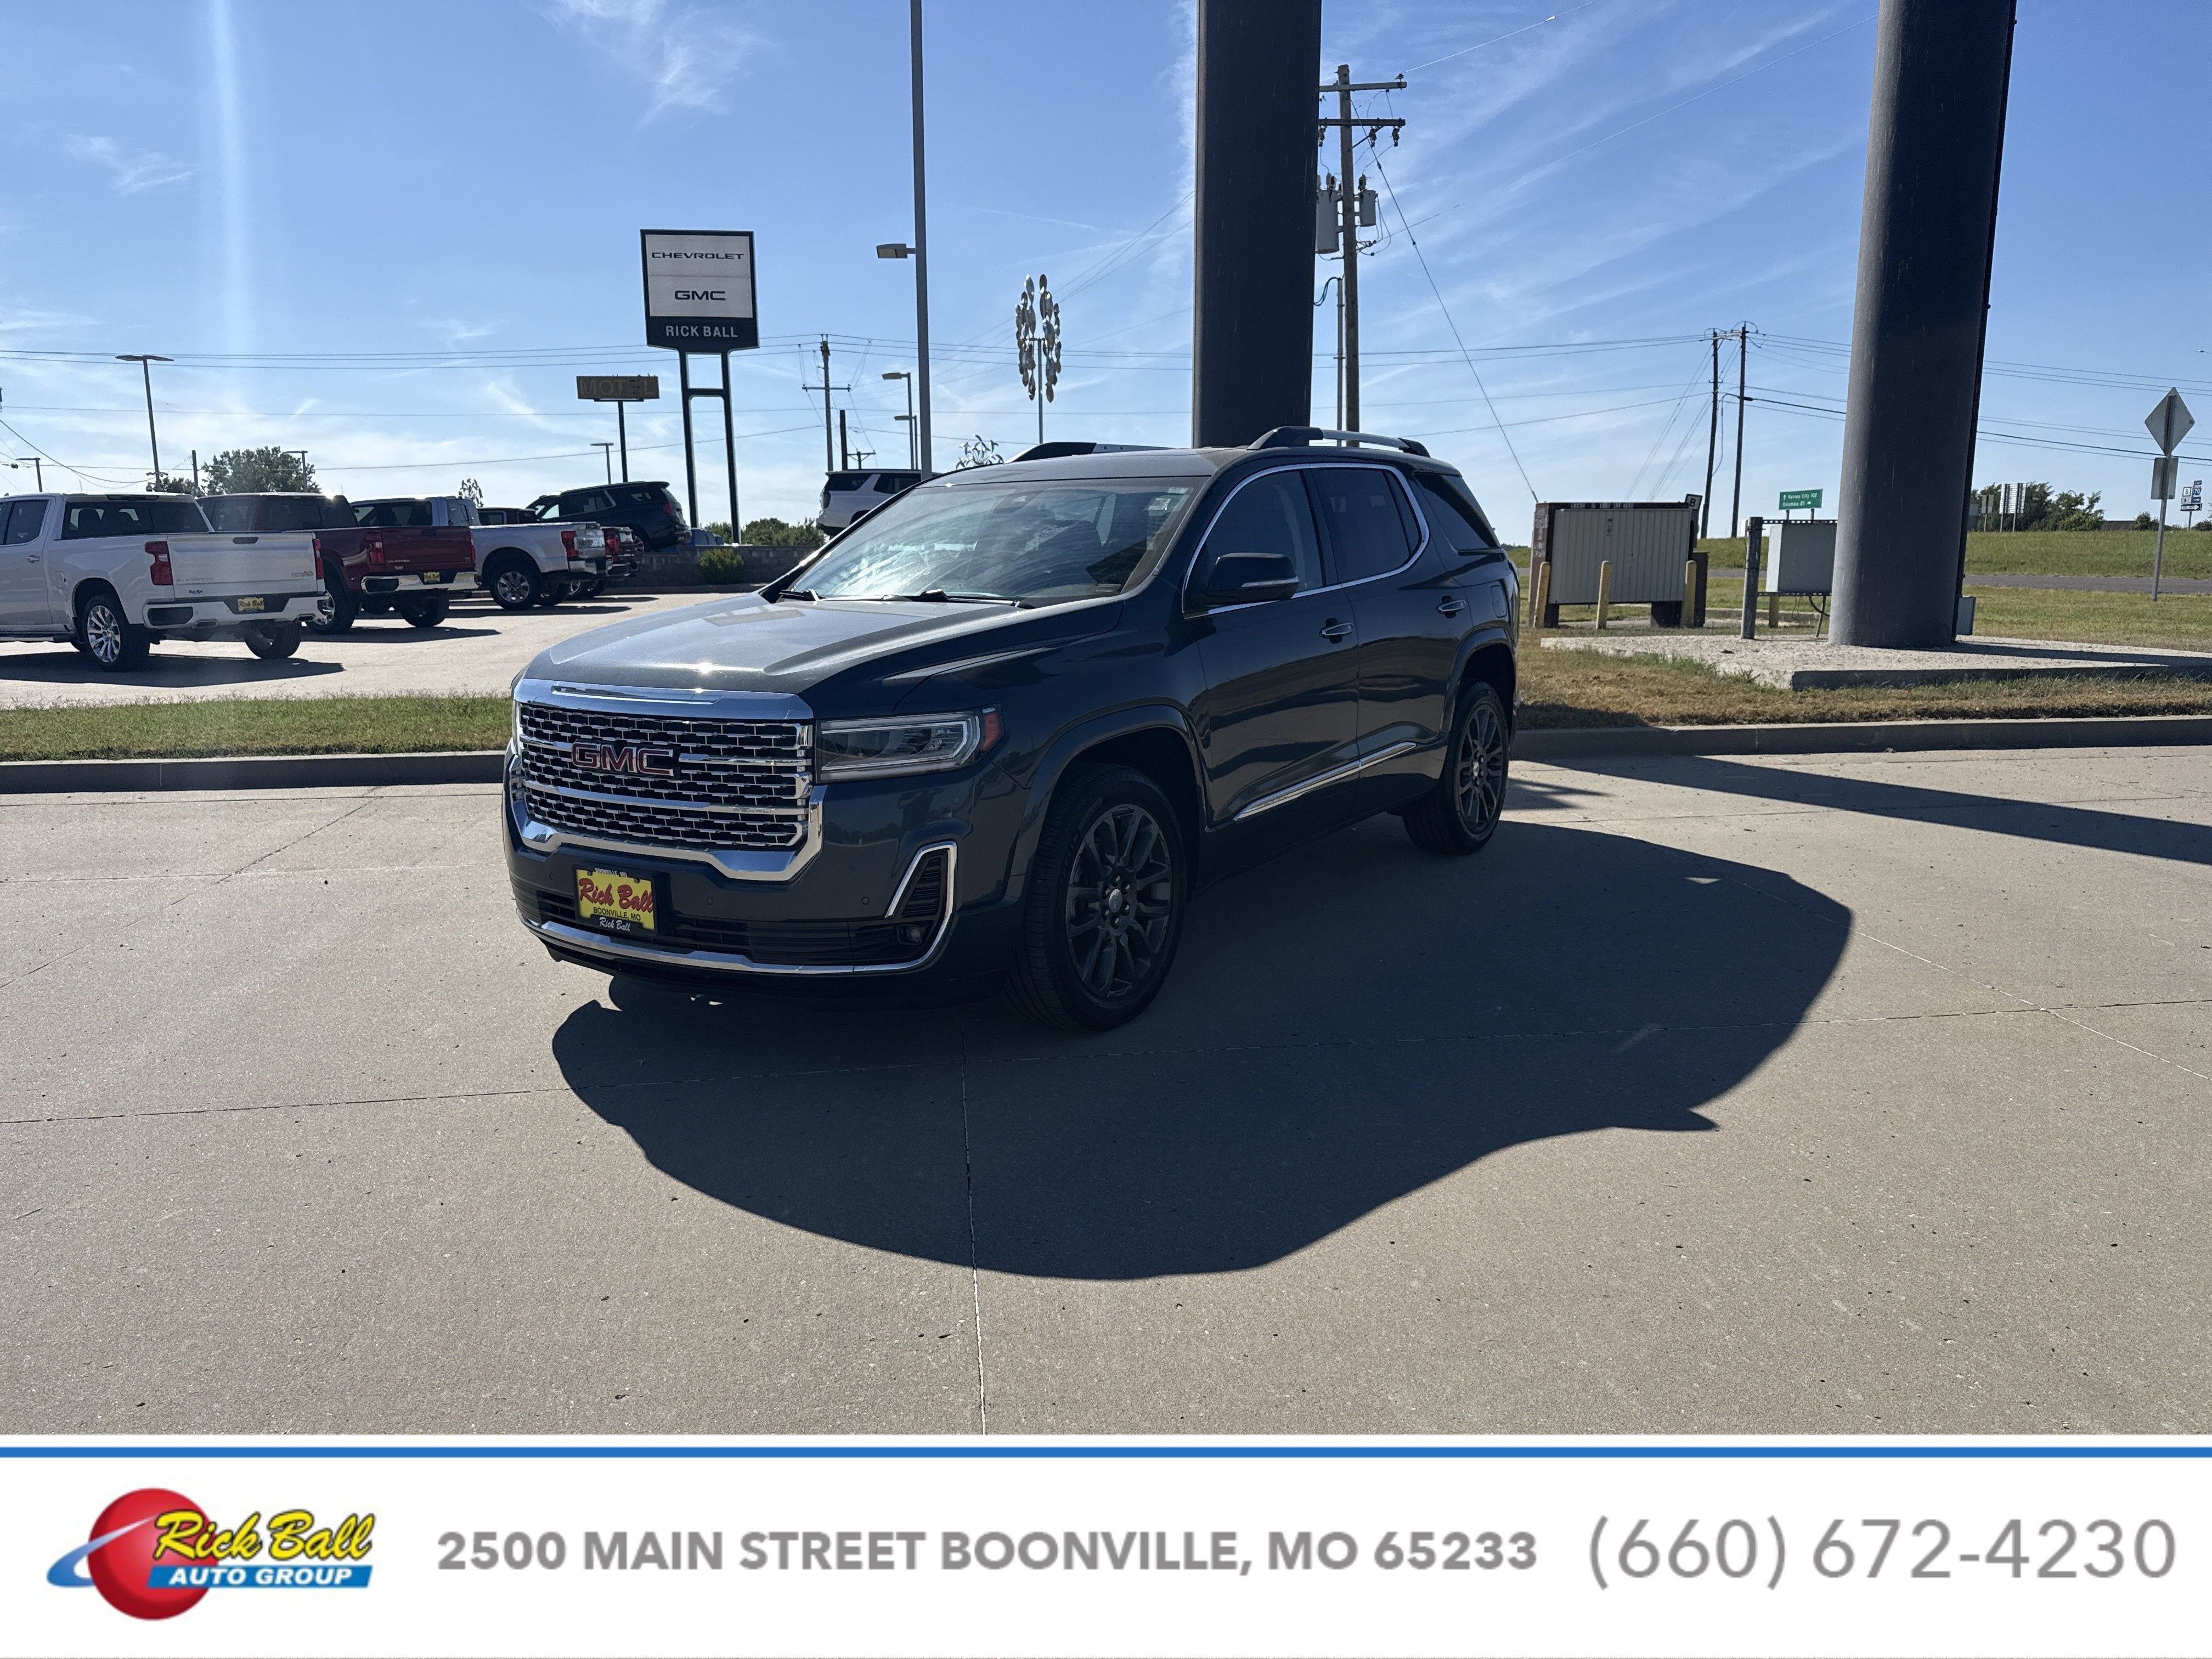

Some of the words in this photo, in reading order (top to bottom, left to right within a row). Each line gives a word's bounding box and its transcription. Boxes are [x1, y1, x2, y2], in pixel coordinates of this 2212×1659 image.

[651, 252, 744, 260] CHEVROLET
[674, 290, 726, 301] GMC
[665, 325, 699, 337] RICK
[703, 326, 738, 338] BALL
[1690, 498, 1697, 507] B
[571, 742, 674, 777] GMC
[579, 878, 614, 906] Rick
[617, 884, 653, 913] Ball
[593, 906, 630, 921] BOONVILLE,
[631, 913, 641, 921] MO
[599, 917, 615, 929] Rick
[616, 919, 631, 932] Ball
